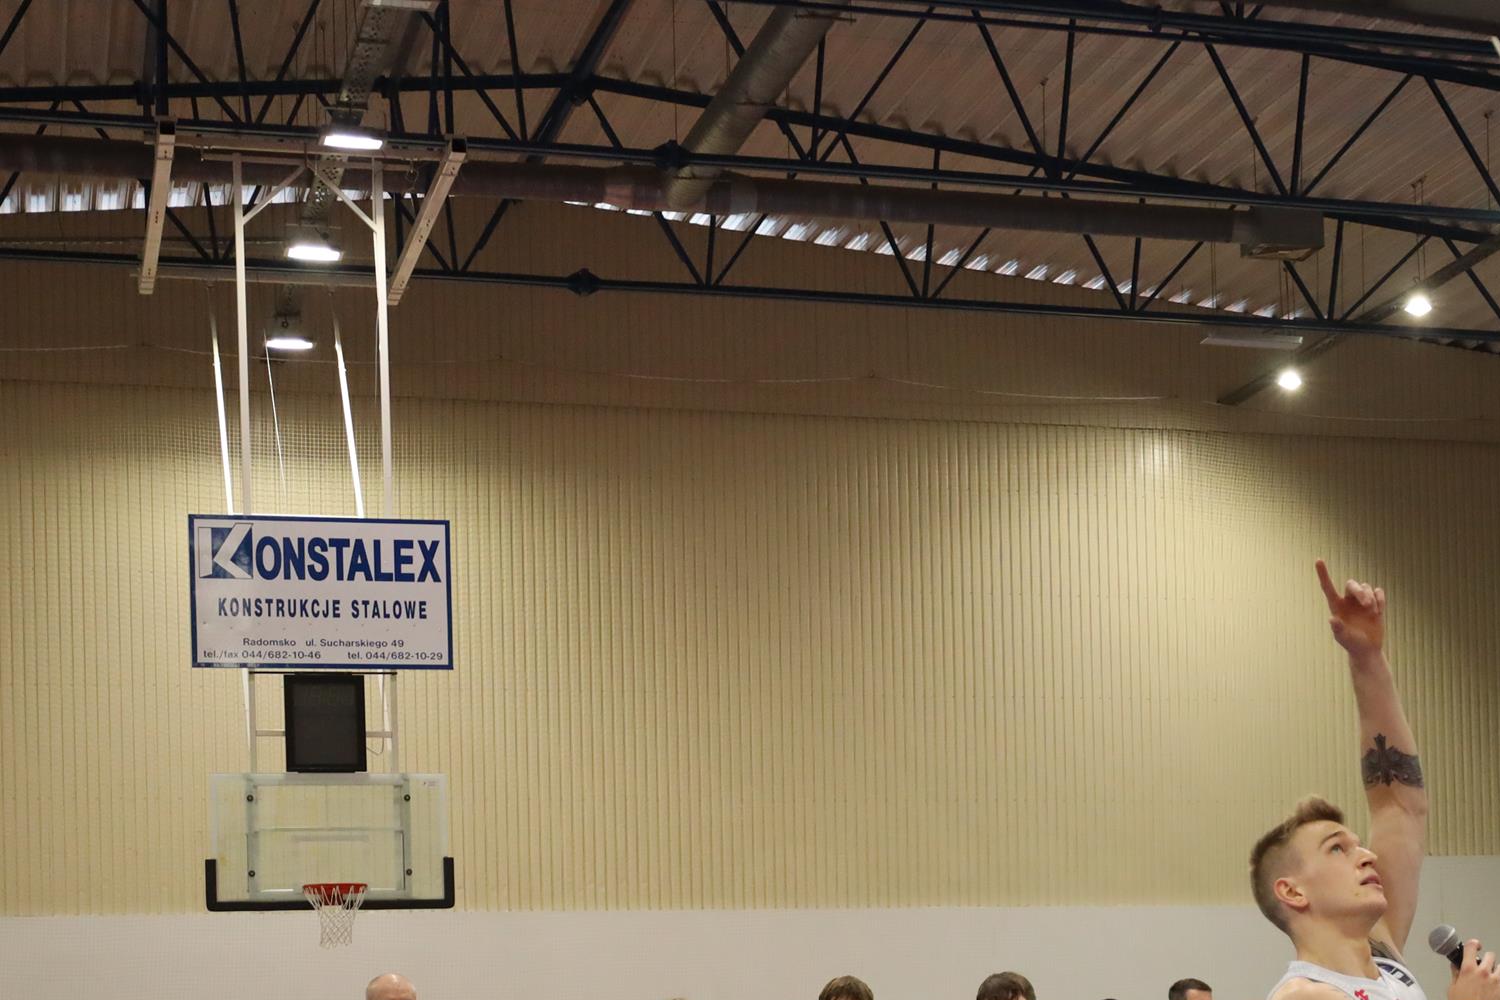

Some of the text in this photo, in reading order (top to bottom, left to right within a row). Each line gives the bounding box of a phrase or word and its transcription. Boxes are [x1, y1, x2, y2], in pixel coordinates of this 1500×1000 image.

[198, 523, 441, 583] KONSTALEX
[218, 598, 428, 620] KONSTRUKCJE STALOWE
[242, 637, 404, 649] Radomsko ul. Sucharskiego 49
[241, 650, 321, 660] 044/682-10-46
[347, 650, 443, 661] tel. 044/682-10-29
